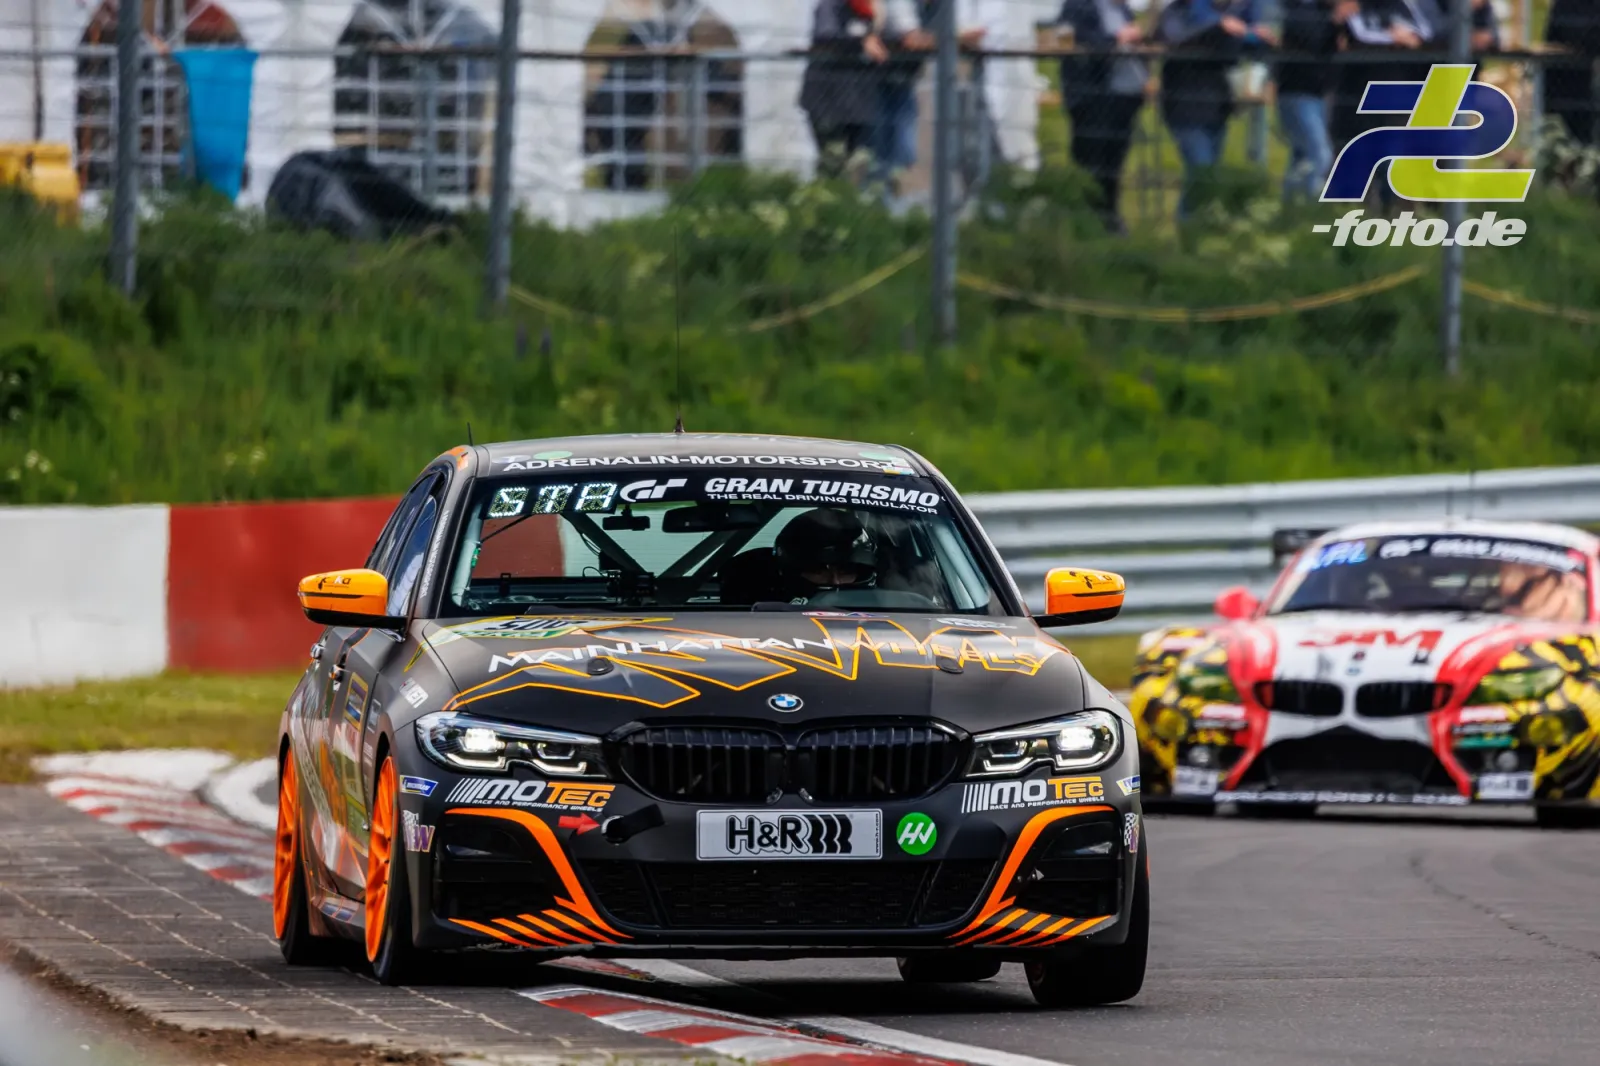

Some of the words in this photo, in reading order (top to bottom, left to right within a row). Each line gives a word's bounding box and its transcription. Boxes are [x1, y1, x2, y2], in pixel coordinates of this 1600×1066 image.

[704, 477, 794, 494] GRAN
[802, 479, 940, 507] TURISMO
[785, 494, 847, 503] DRIVING
[851, 498, 938, 515] SIMULATOR
[488, 637, 833, 673] MAINHATTAN
[476, 778, 616, 807] MOTEC
[990, 776, 1104, 804] MOTEC
[1028, 799, 1077, 807] PERFORMANCE
[511, 801, 568, 810] PERFORMANCE
[570, 804, 603, 812] WHEELS
[726, 815, 809, 854] H&R
